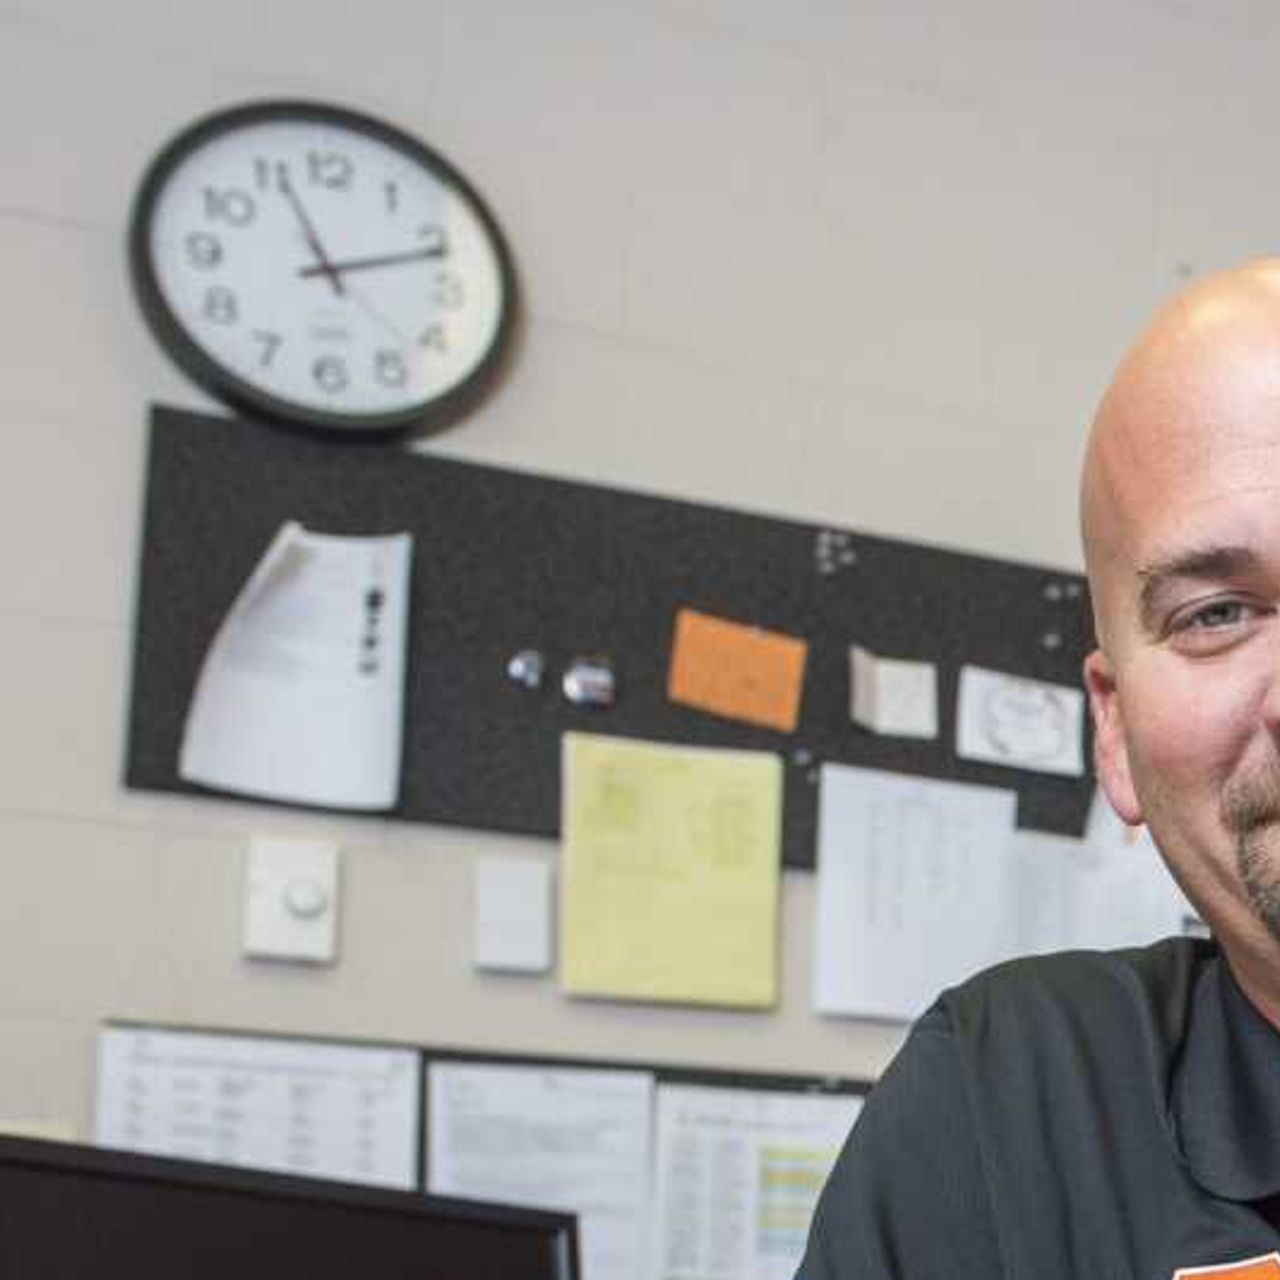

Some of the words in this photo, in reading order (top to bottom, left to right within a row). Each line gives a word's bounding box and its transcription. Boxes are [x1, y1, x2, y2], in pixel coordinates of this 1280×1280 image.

[255, 157, 292, 191] 11
[307, 151, 355, 190] 12
[205, 187, 256, 227] 10
[386, 179, 399, 213] 1
[187, 233, 223, 270] 9
[205, 286, 239, 324] 8
[433, 271, 463, 308] 3
[253, 329, 283, 368] 7
[419, 322, 449, 352] 4
[312, 357, 349, 393] 6
[376, 349, 408, 386] 5
